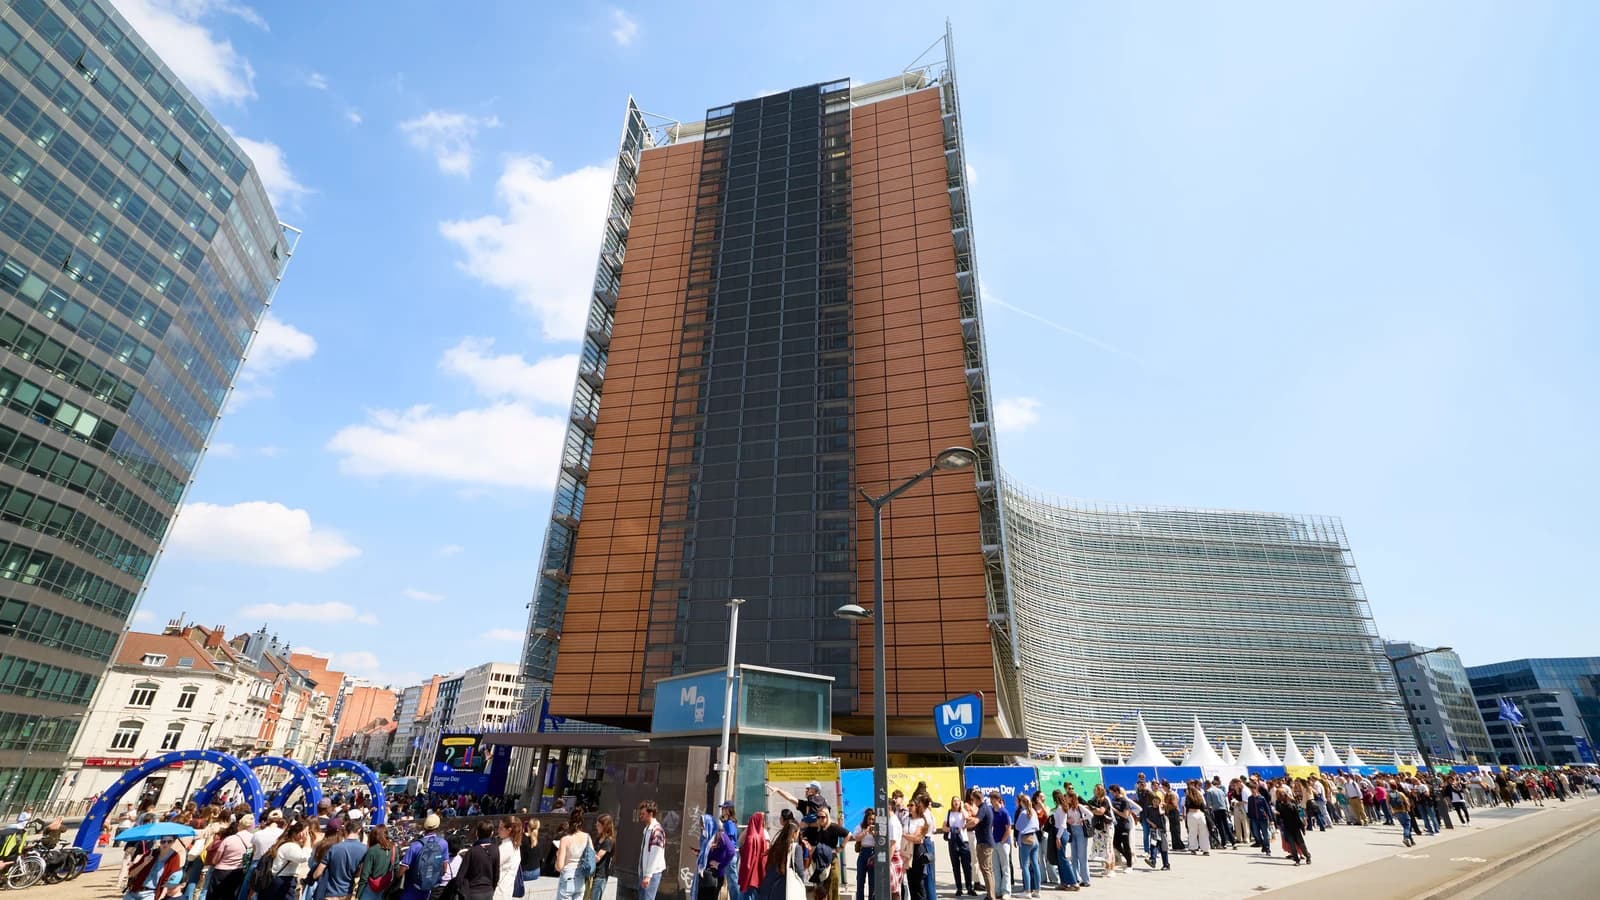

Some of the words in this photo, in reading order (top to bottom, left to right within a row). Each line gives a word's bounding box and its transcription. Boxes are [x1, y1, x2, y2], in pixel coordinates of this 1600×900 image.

[680, 686, 697, 706] M
[943, 704, 972, 725] M
[954, 726, 963, 737] B
[1000, 784, 1016, 797] Day
